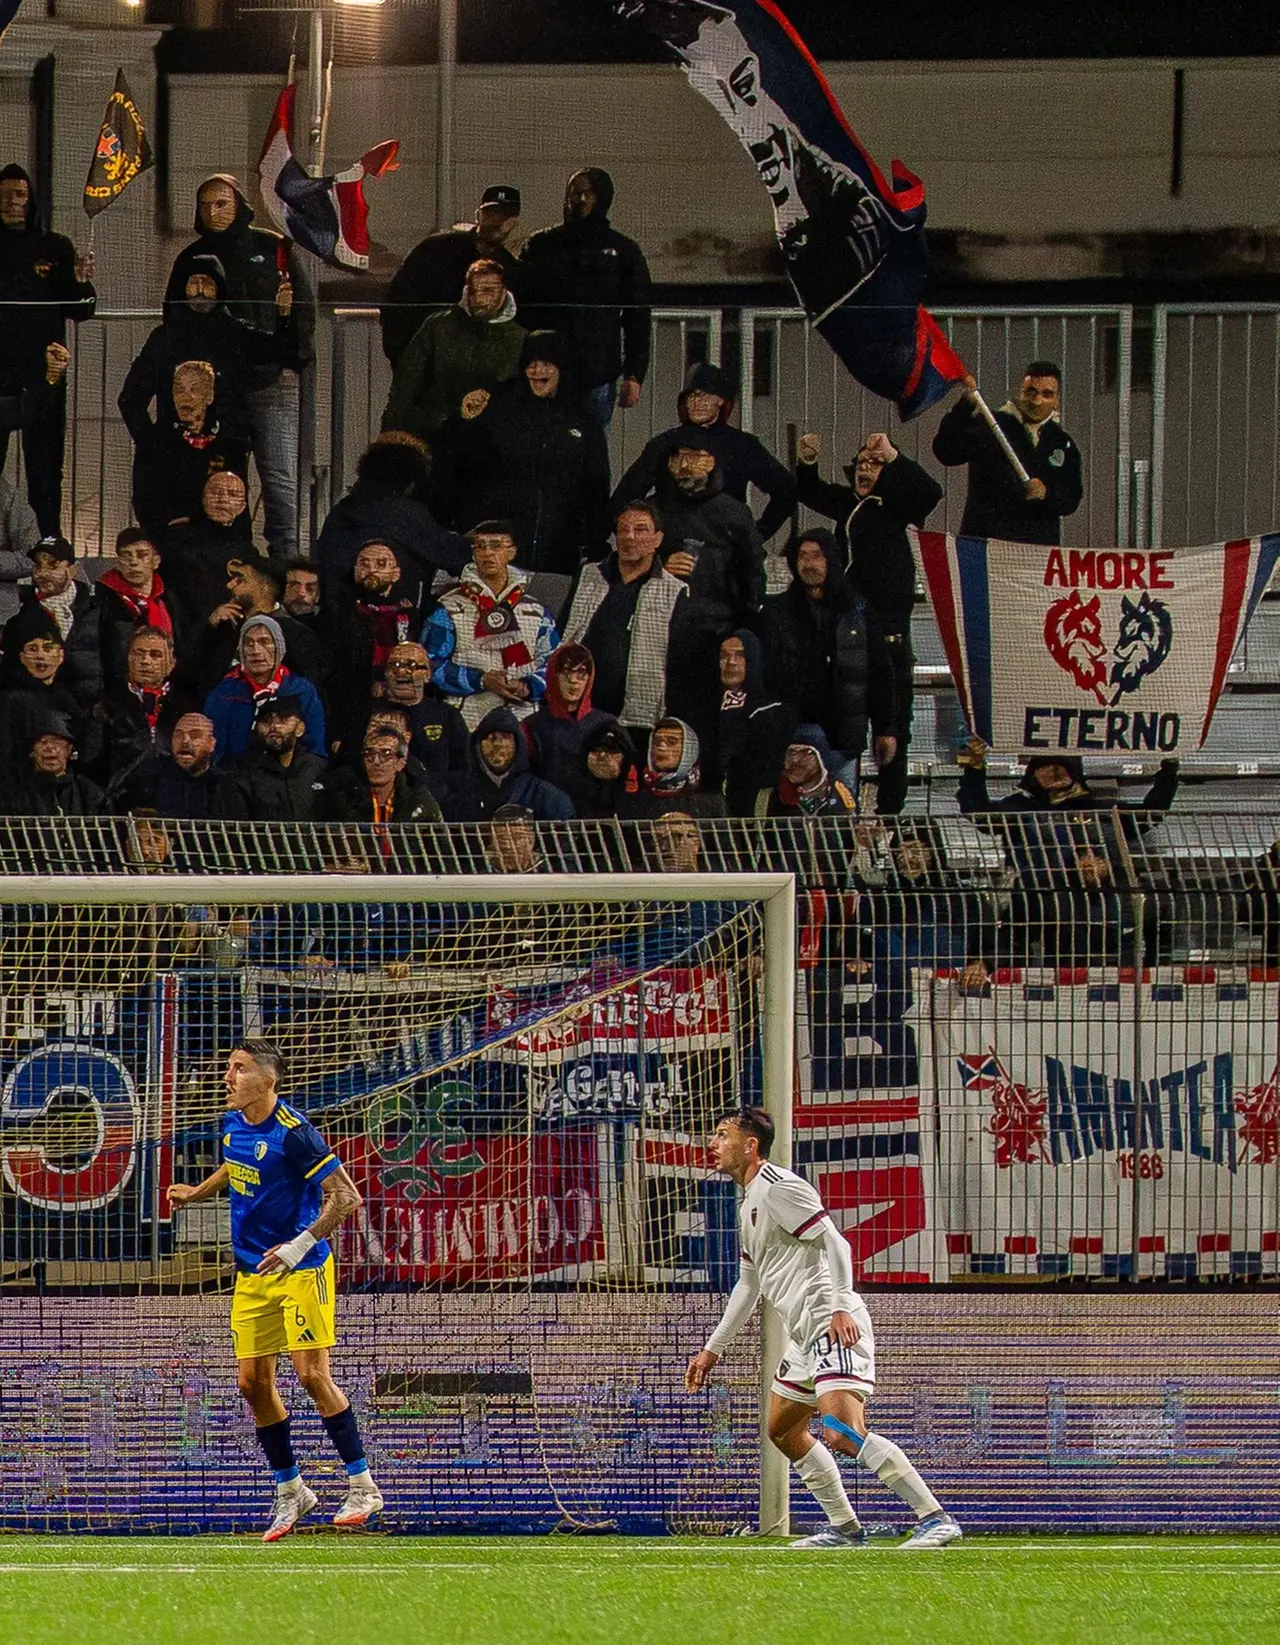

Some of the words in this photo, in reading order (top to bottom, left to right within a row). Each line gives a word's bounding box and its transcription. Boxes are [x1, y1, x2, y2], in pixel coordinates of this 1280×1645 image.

[1044, 550, 1175, 589] AMORE
[1024, 706, 1181, 751] ETERNO
[1045, 1052, 1237, 1174] AMANTEA
[295, 1304, 306, 1327] 6
